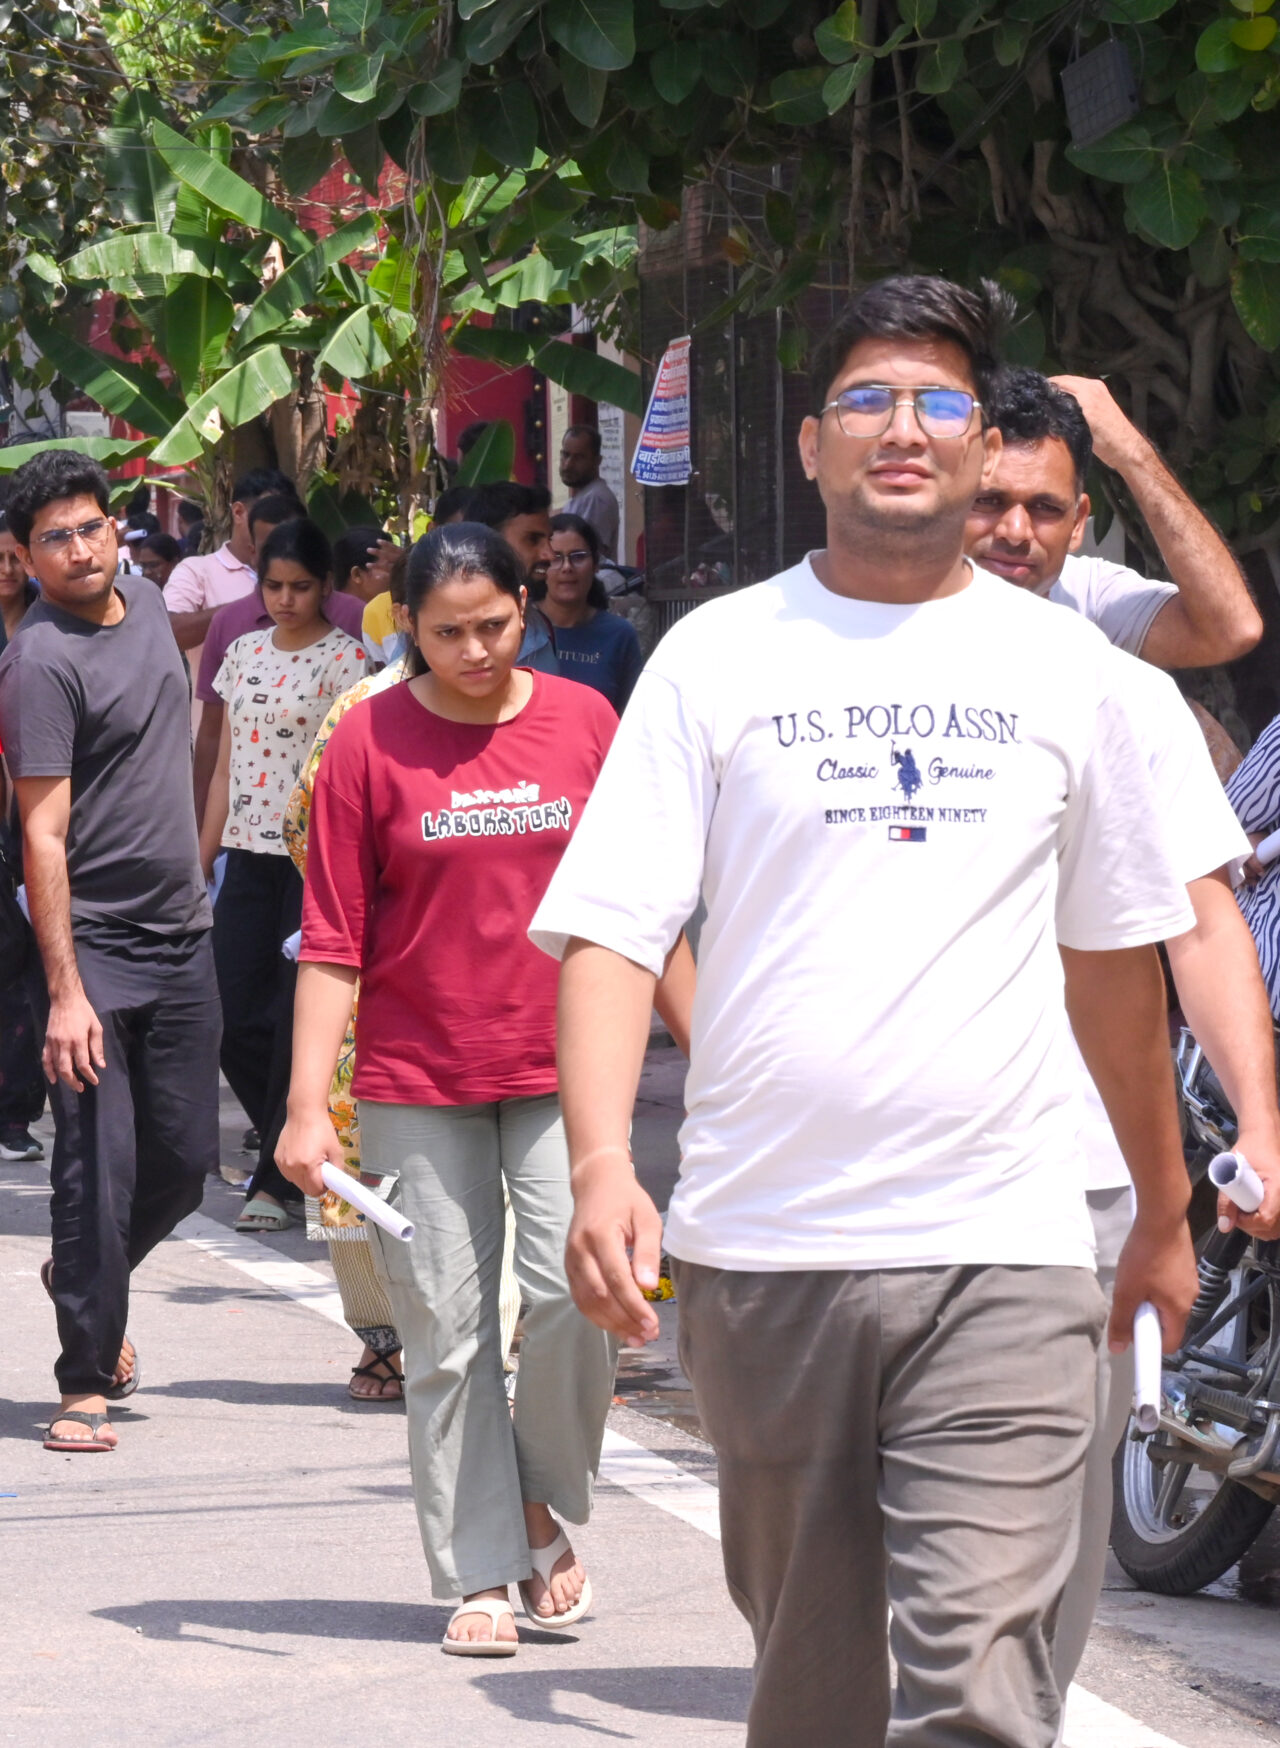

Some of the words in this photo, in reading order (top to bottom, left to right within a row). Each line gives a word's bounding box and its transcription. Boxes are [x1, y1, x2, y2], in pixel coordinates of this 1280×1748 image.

[772, 710, 833, 747] U.S.
[844, 704, 935, 738] POLO
[816, 757, 879, 782] Classic
[928, 757, 996, 785] Genuine
[422, 796, 572, 841] LABORATORY
[825, 807, 866, 824] SINCE
[869, 805, 934, 822] EIGHTEEN
[938, 807, 987, 823] NINETY
